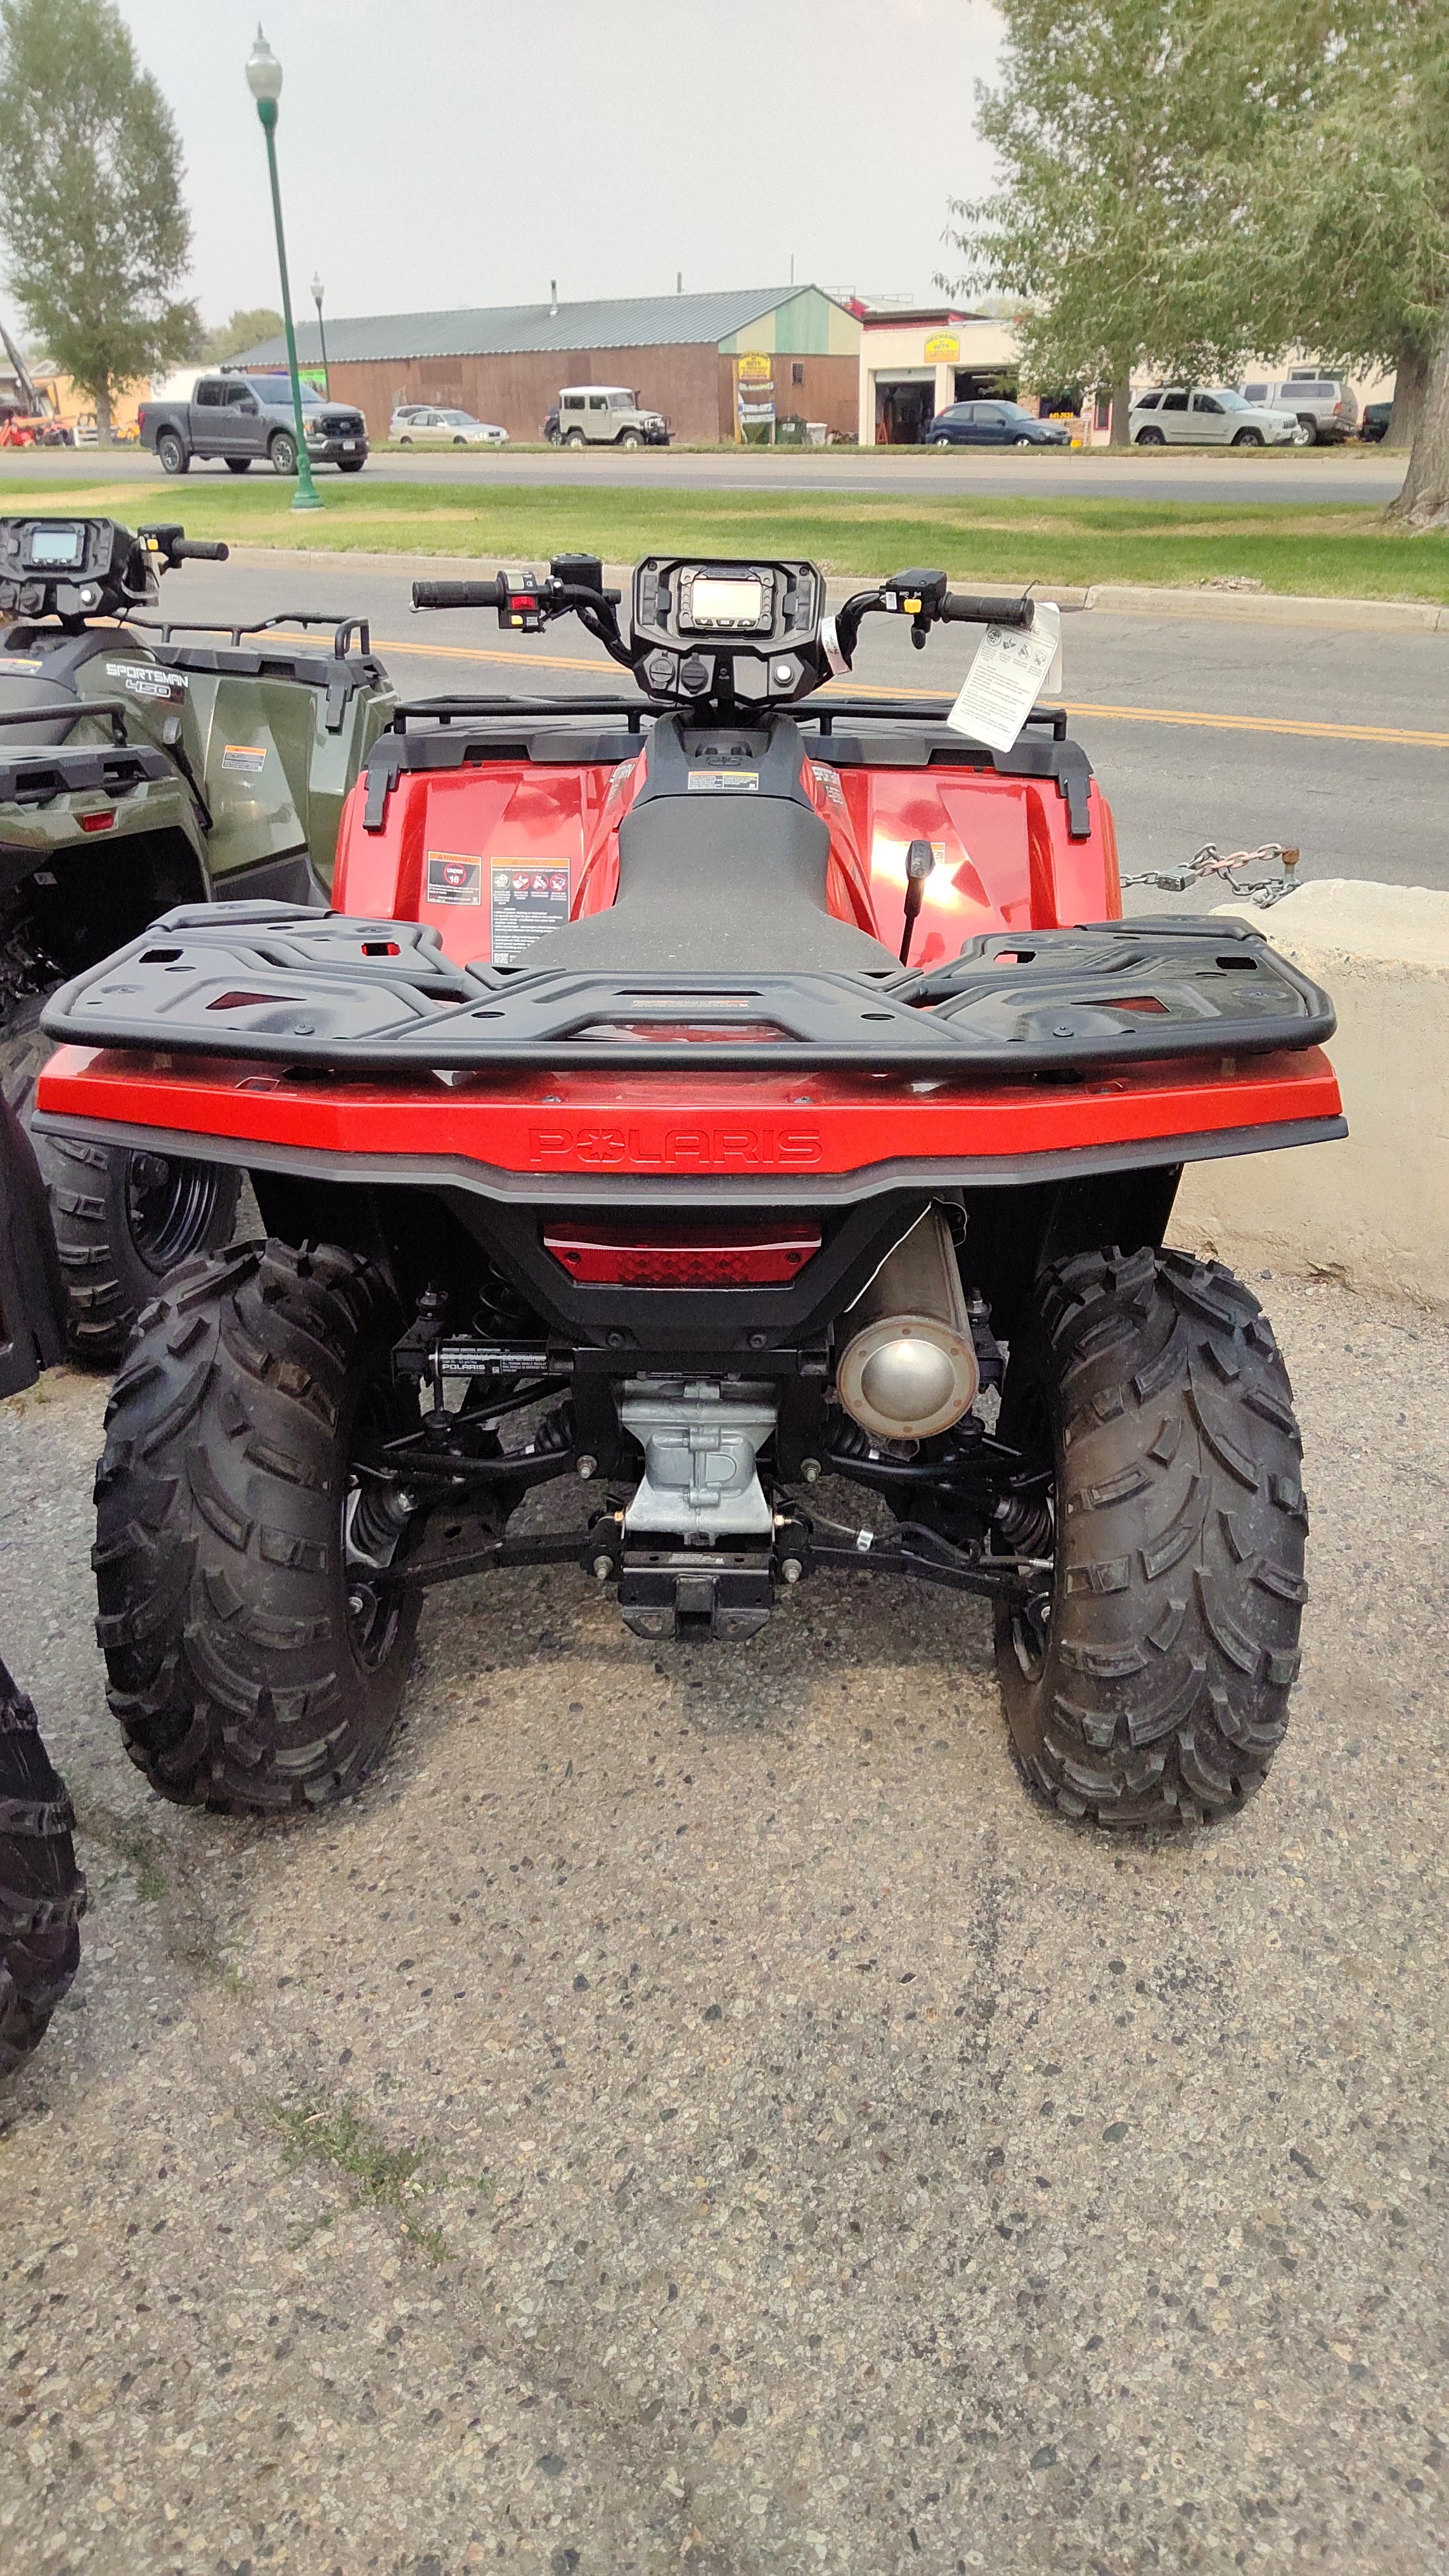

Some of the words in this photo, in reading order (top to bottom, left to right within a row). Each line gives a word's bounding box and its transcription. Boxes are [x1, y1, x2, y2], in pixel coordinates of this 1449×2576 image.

[106, 662, 189, 688] SPORTSMAN
[126, 679, 171, 699] 450
[449, 875, 460, 884] 16
[529, 1128, 823, 1164] POLARIS
